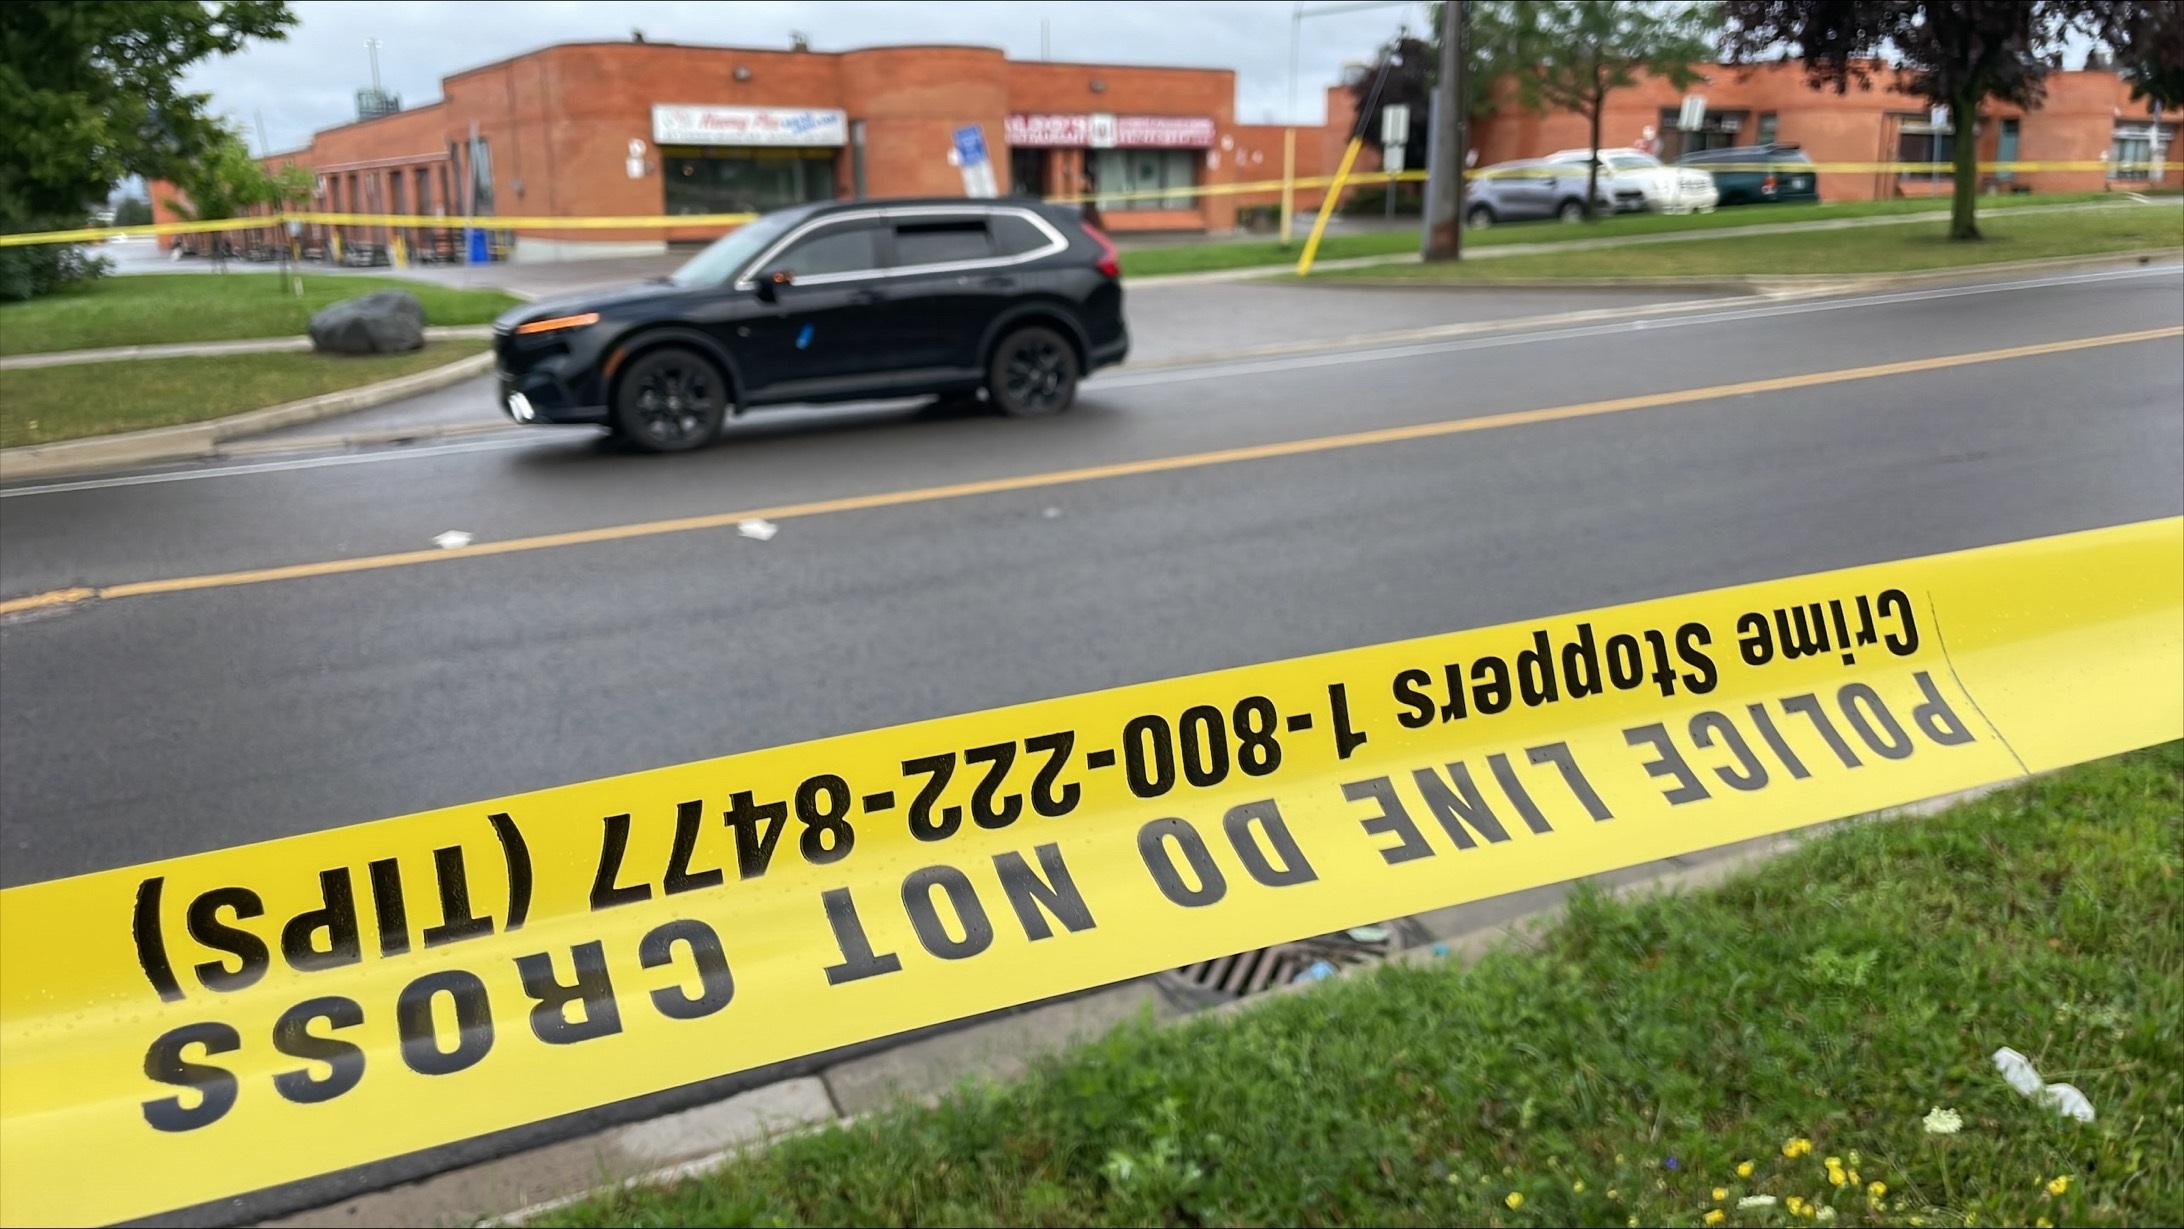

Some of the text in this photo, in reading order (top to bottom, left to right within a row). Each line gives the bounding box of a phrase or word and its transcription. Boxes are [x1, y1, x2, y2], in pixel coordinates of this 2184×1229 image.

[132, 588, 1919, 1003] Crime Stoppers 1-800-222-8477 (TIPS)
[142, 671, 1976, 1133] POLICE LINE DO NOT CROSS
